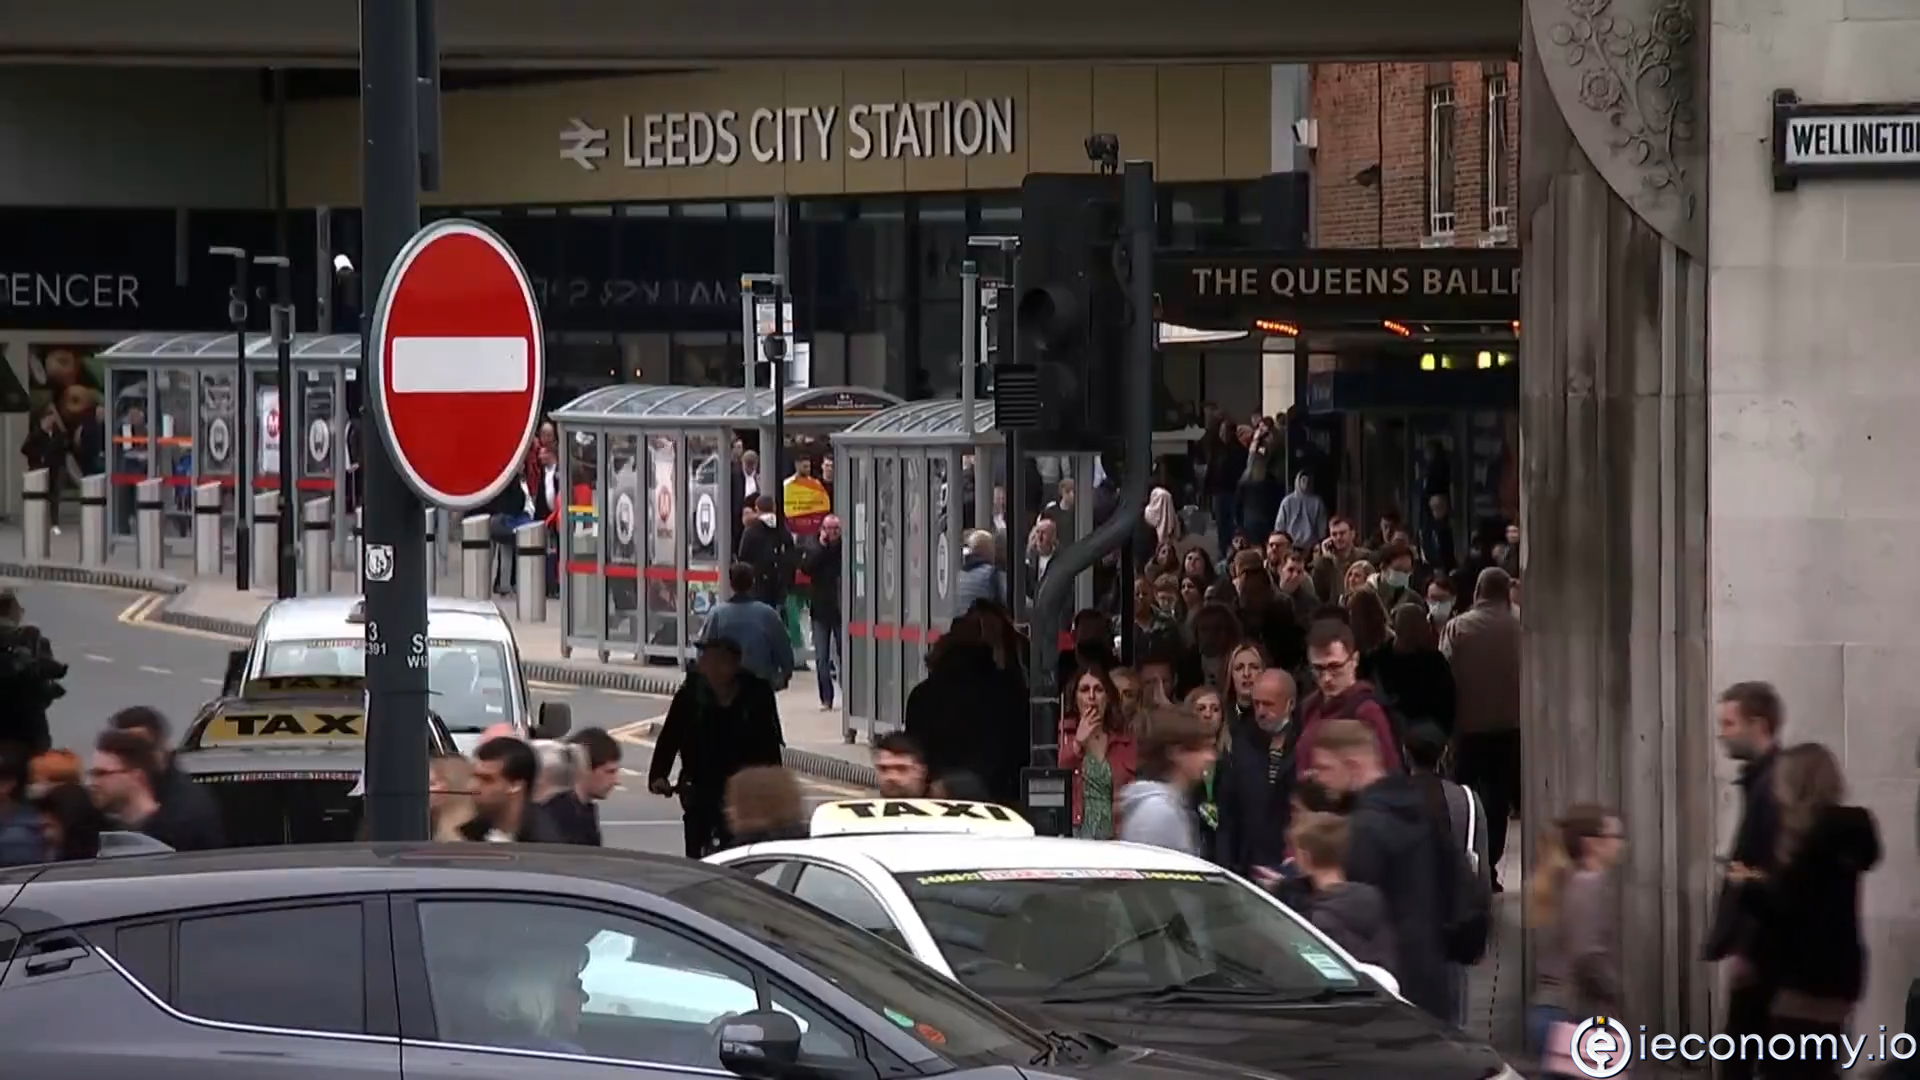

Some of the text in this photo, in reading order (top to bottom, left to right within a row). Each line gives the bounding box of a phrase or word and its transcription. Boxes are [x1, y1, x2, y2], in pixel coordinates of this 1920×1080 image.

[624, 96, 1016, 168] LEEDS CITY STATION
[1192, 267, 1258, 296] THE
[1270, 266, 1410, 298] QUEENS
[368, 621, 378, 641] 3
[366, 641, 387, 656] 391
[837, 801, 1012, 822] TAXI
